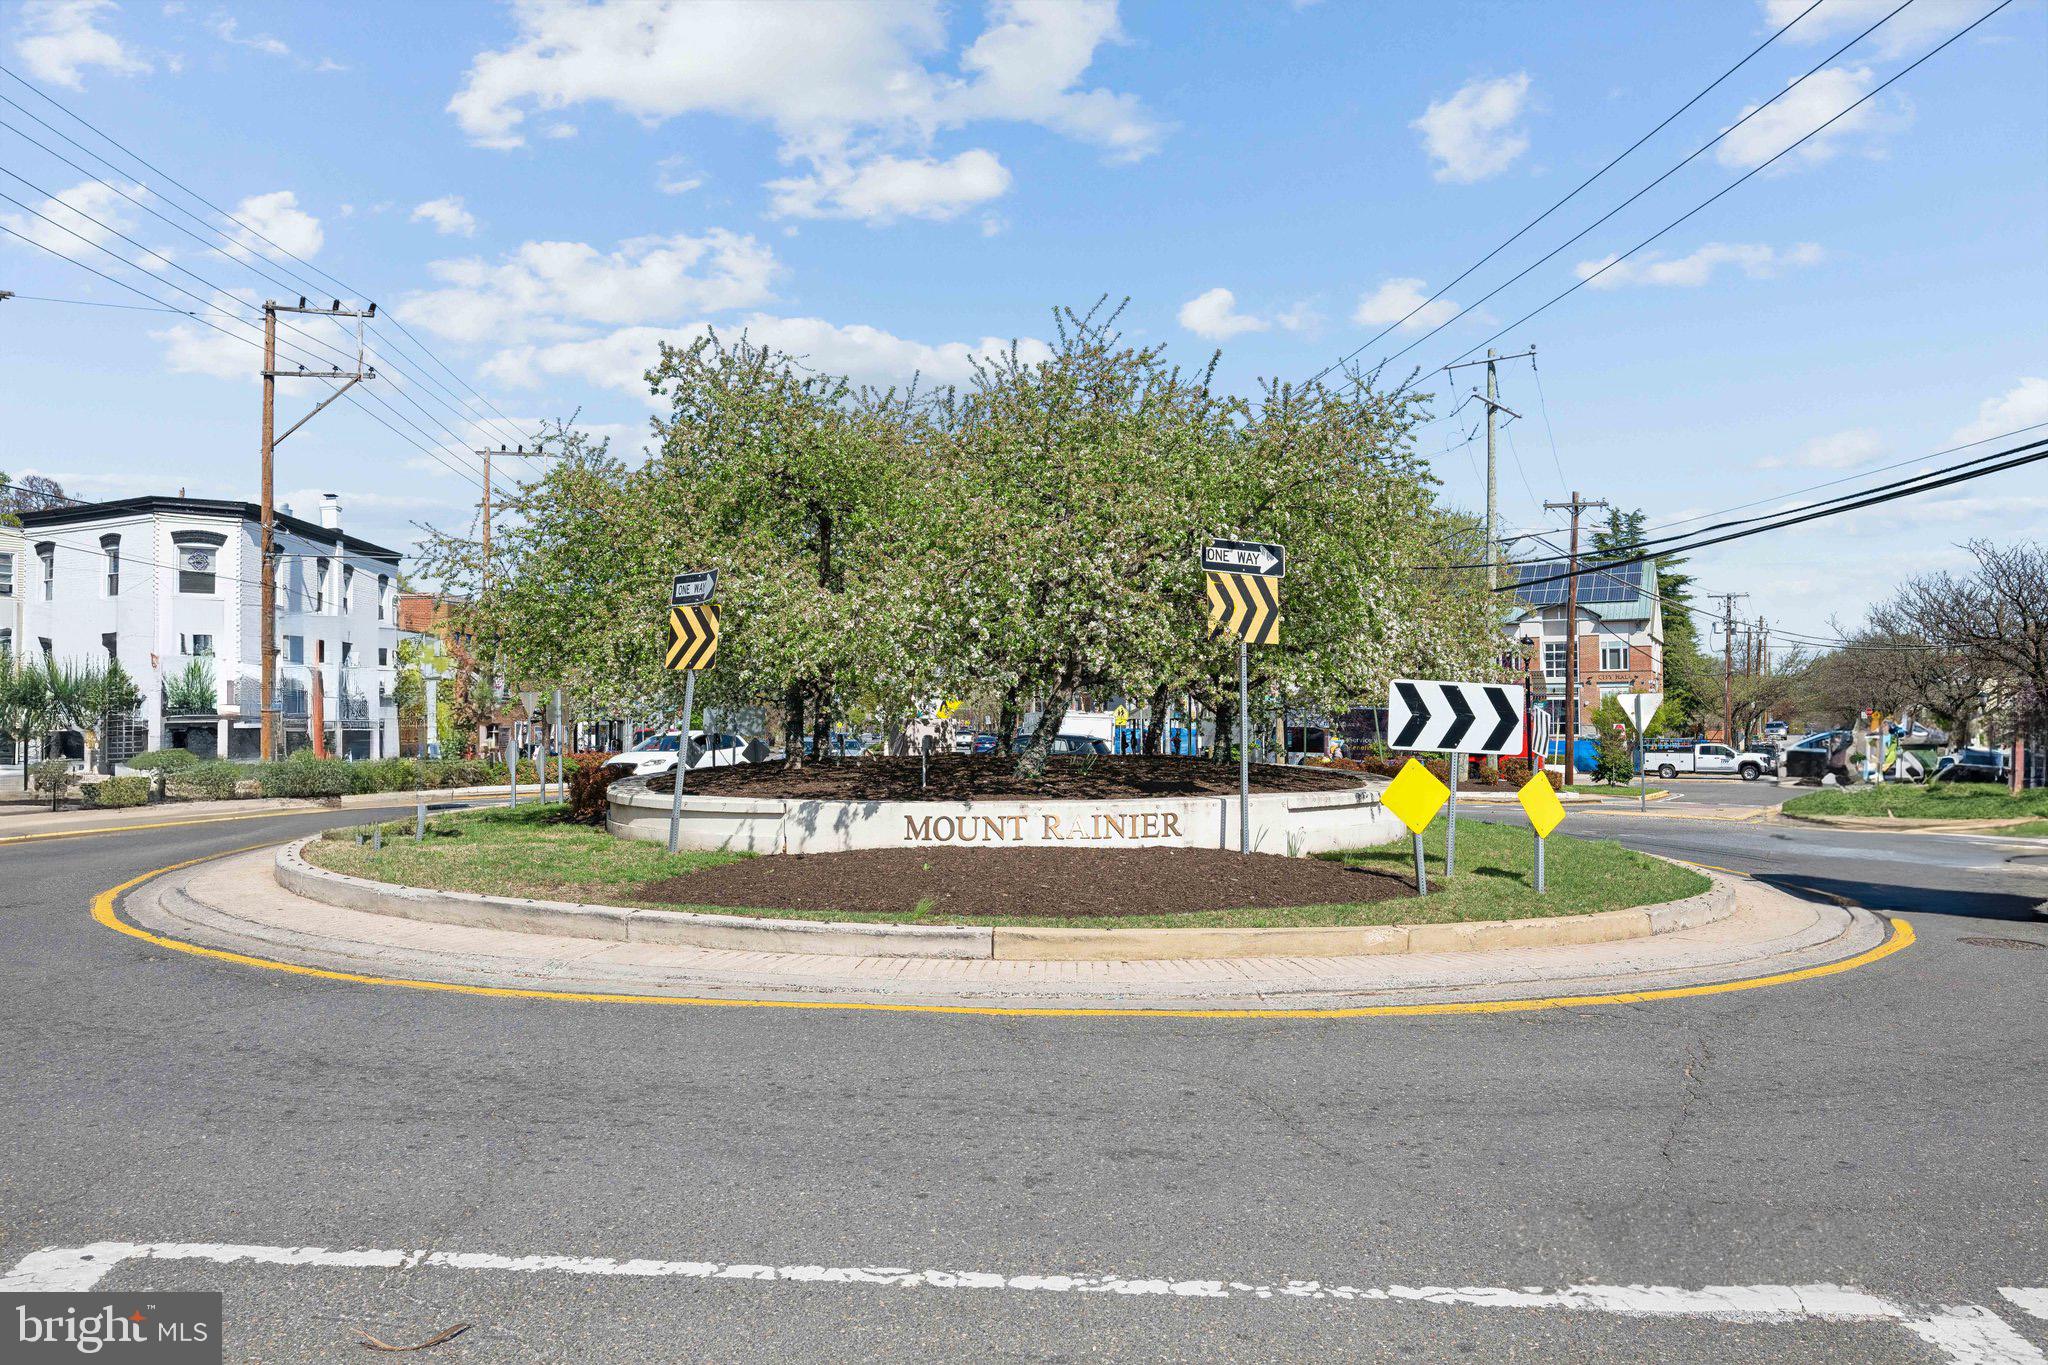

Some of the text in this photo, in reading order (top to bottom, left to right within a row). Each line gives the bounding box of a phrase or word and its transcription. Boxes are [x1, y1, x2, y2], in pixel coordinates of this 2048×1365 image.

[1207, 548, 1260, 565] ONE WAY
[678, 581, 707, 595] ONE WAY
[903, 812, 1182, 841] MOUNT RAINIER
